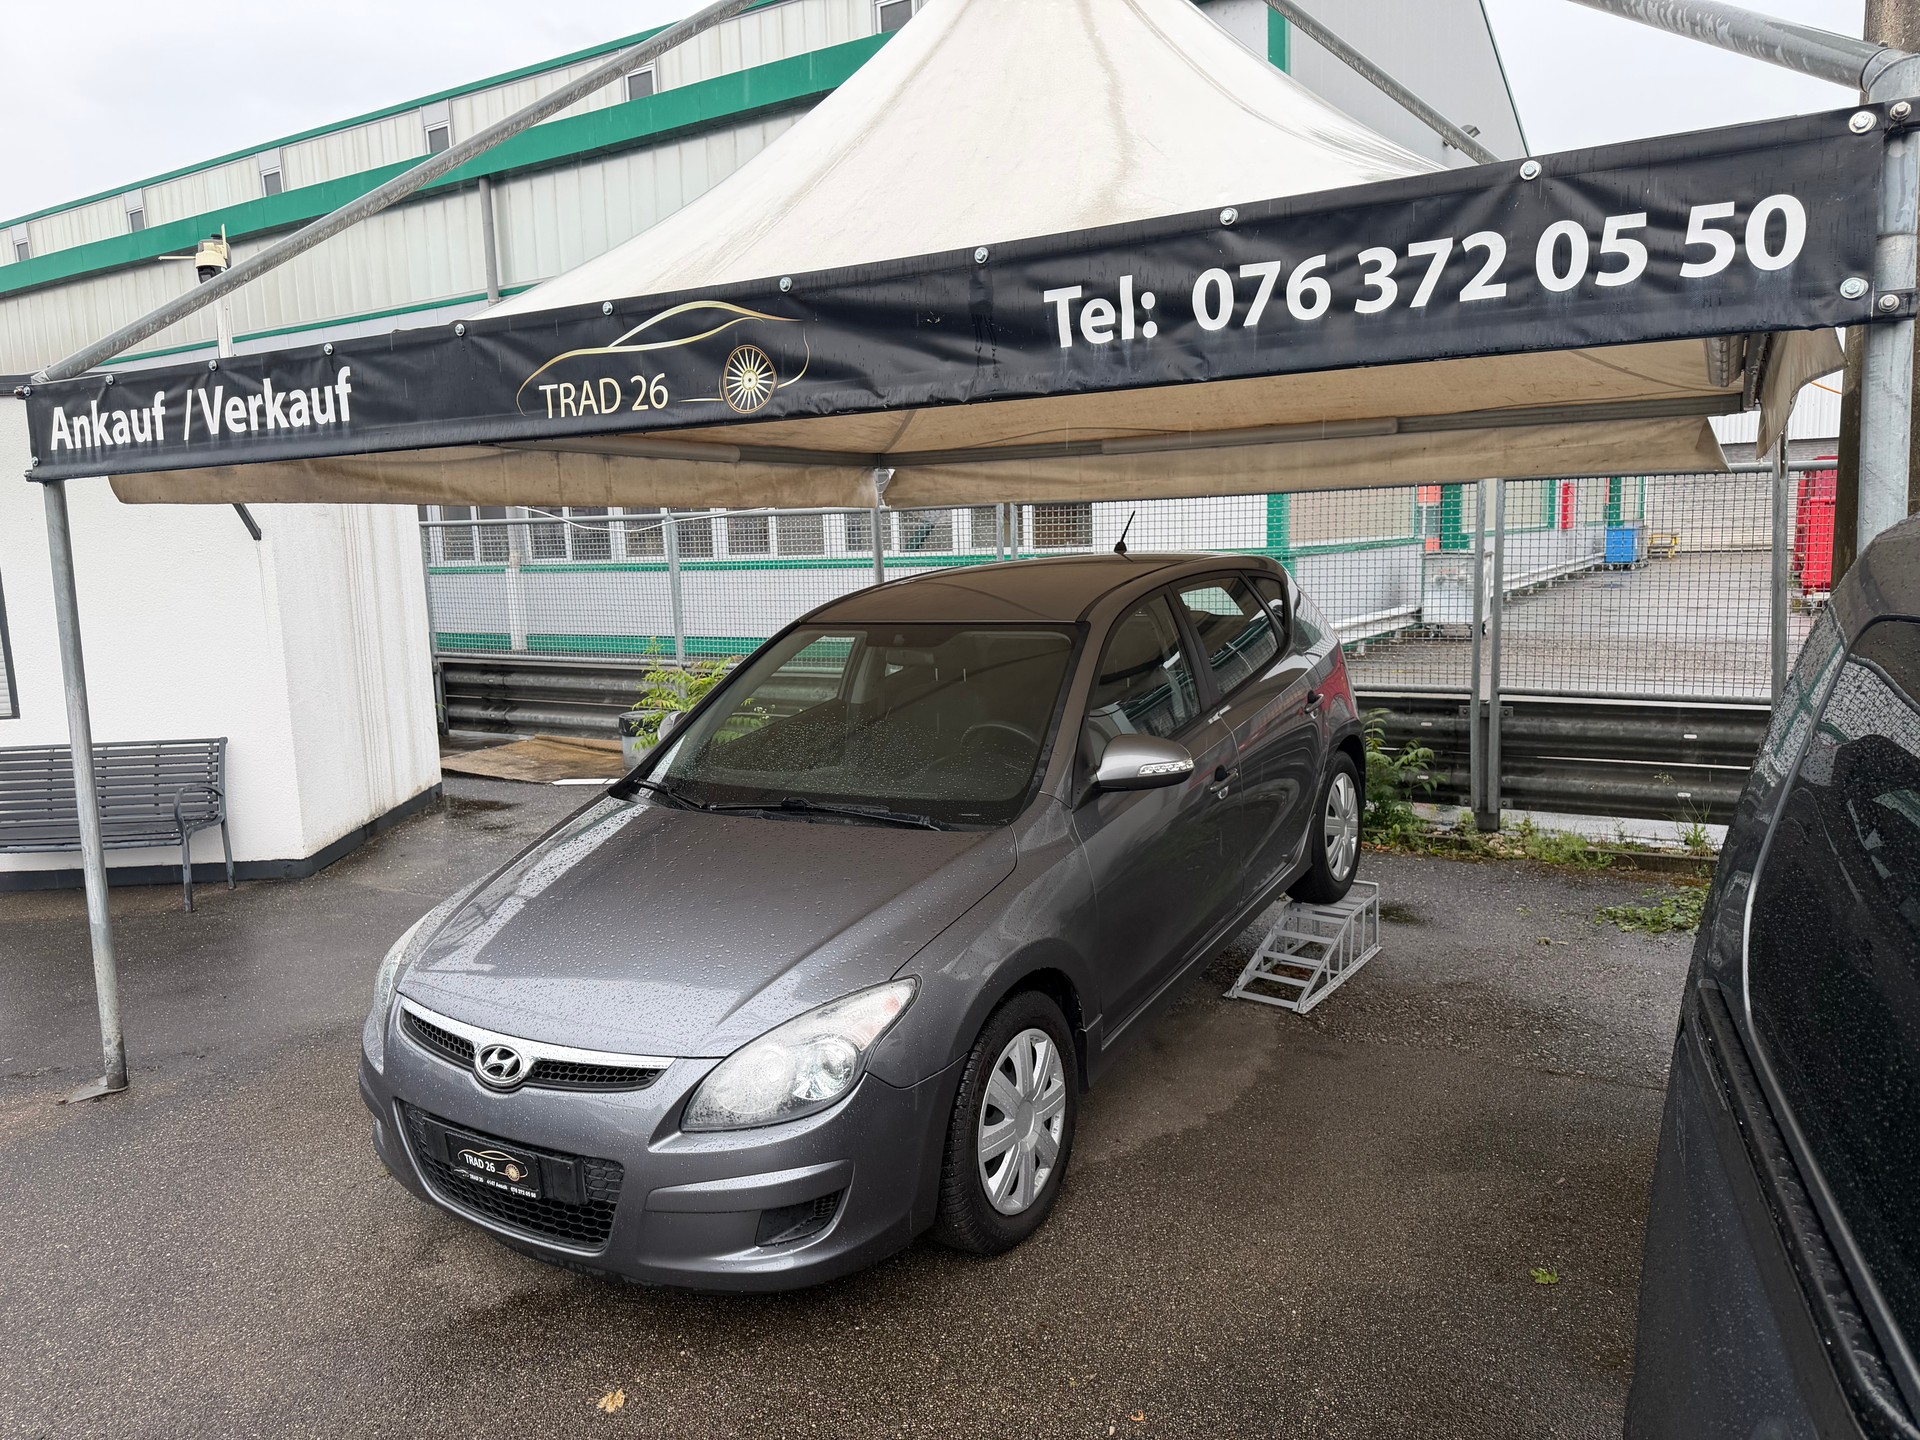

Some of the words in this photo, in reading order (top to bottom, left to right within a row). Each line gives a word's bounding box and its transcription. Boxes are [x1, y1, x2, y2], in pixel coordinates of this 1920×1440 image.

[1043, 275, 1158, 349] Tel:
[1191, 253, 1332, 332] 076
[1354, 230, 1507, 314] 372
[1535, 211, 1648, 293] 05
[1680, 193, 1807, 279] 50
[50, 390, 166, 450] Ankauf
[538, 378, 622, 420] TRAD
[630, 372, 669, 412] 26
[463, 1153, 485, 1169] TRAD
[484, 1161, 496, 1173] 26
